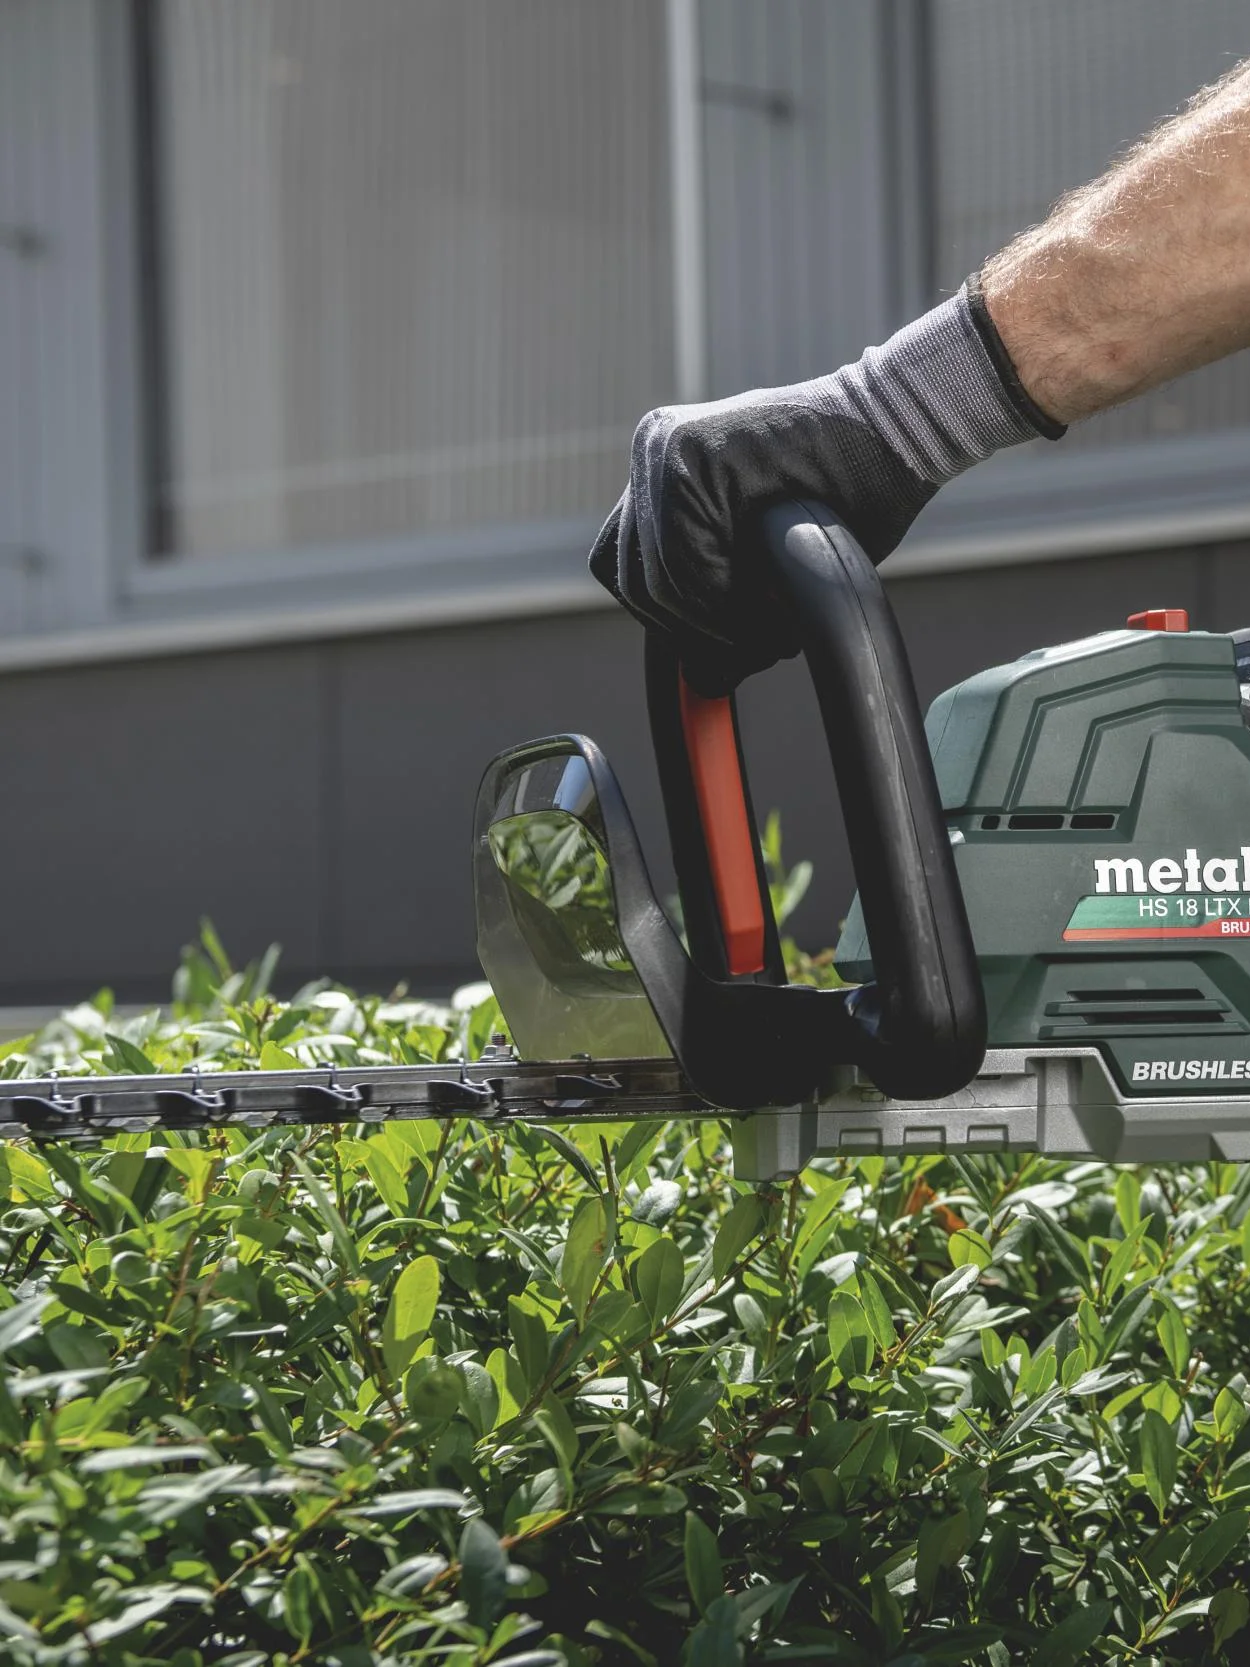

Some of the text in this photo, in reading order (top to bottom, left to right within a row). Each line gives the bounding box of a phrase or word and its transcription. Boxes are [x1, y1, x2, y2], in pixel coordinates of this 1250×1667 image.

[1139, 898, 1168, 917] HS
[1176, 898, 1198, 916] 18
[1204, 898, 1241, 916] LTX
